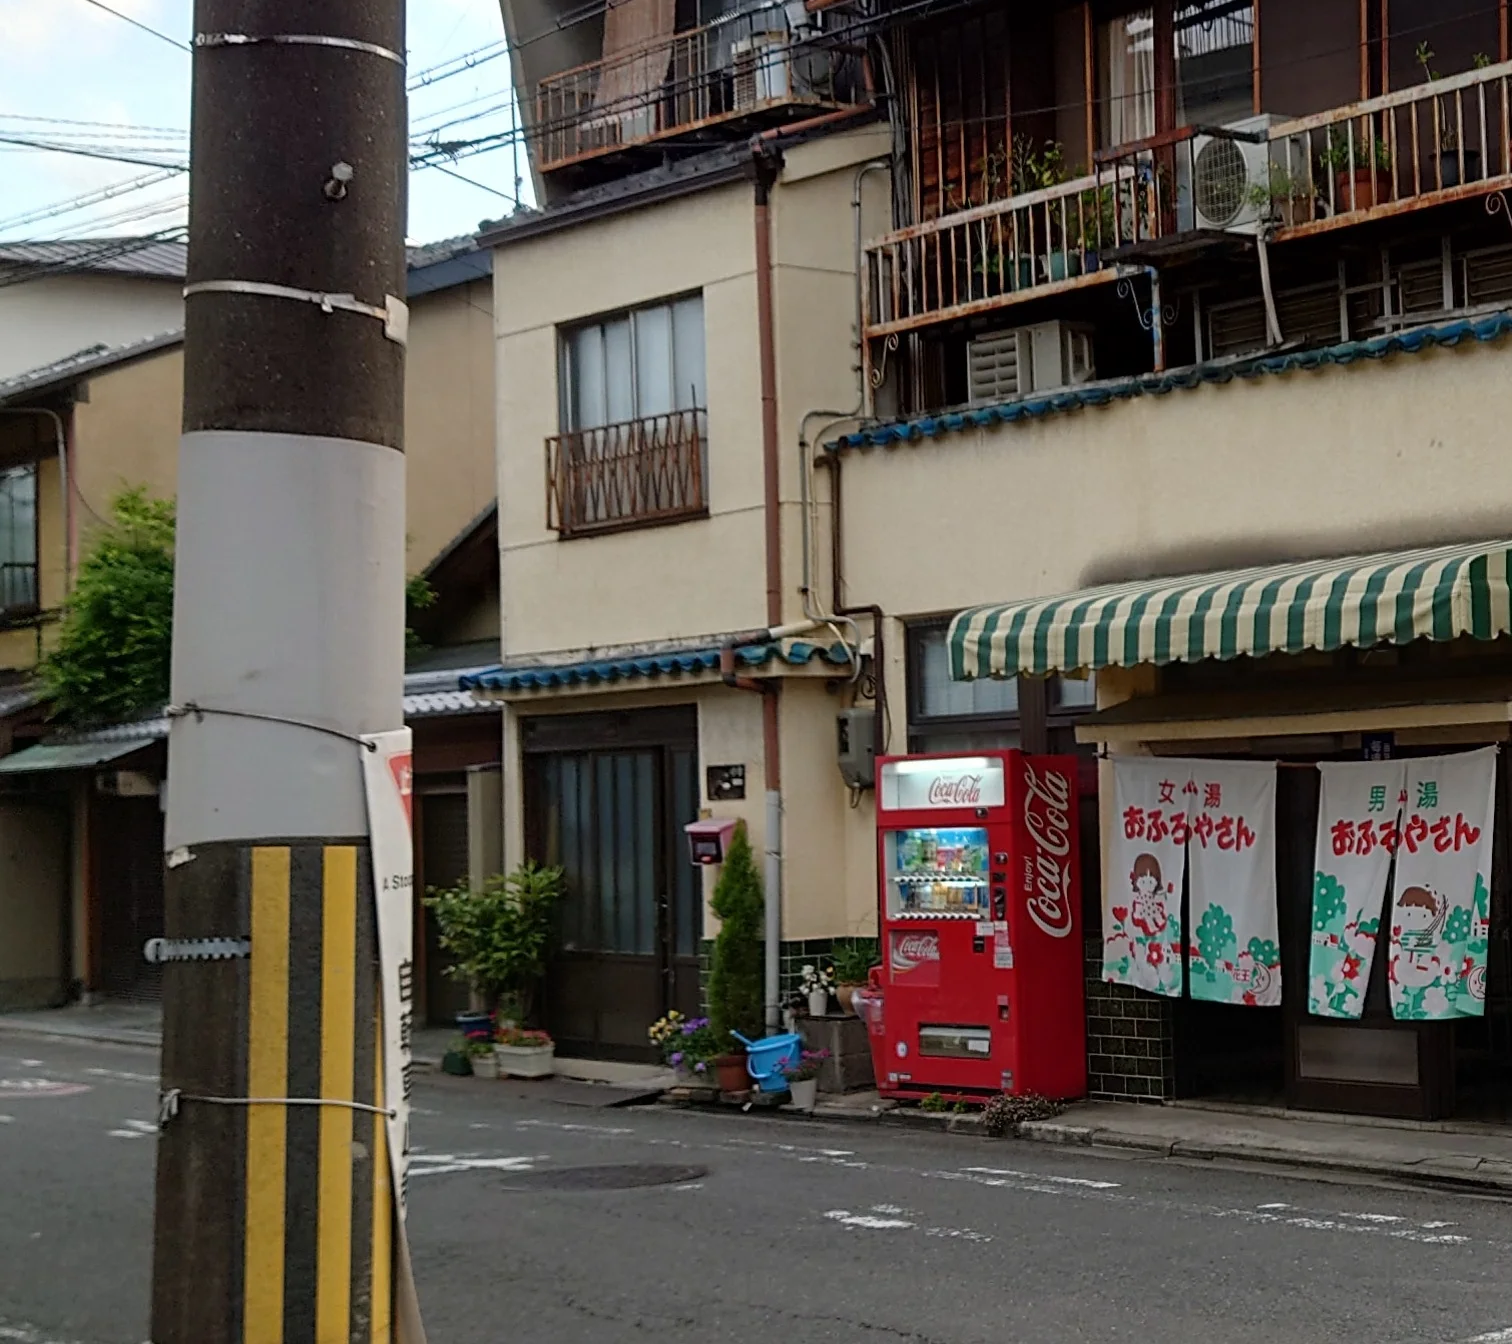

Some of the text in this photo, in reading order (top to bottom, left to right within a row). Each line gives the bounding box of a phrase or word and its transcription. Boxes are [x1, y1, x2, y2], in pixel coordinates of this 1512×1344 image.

[1158, 779, 1222, 808] 女 湯
[1368, 781, 1439, 813] 男 湯
[1122, 805, 1257, 852] おふろやさん
[1023, 760, 1073, 938] Coca-Cola
[1024, 856, 1033, 892] Enjoy!
